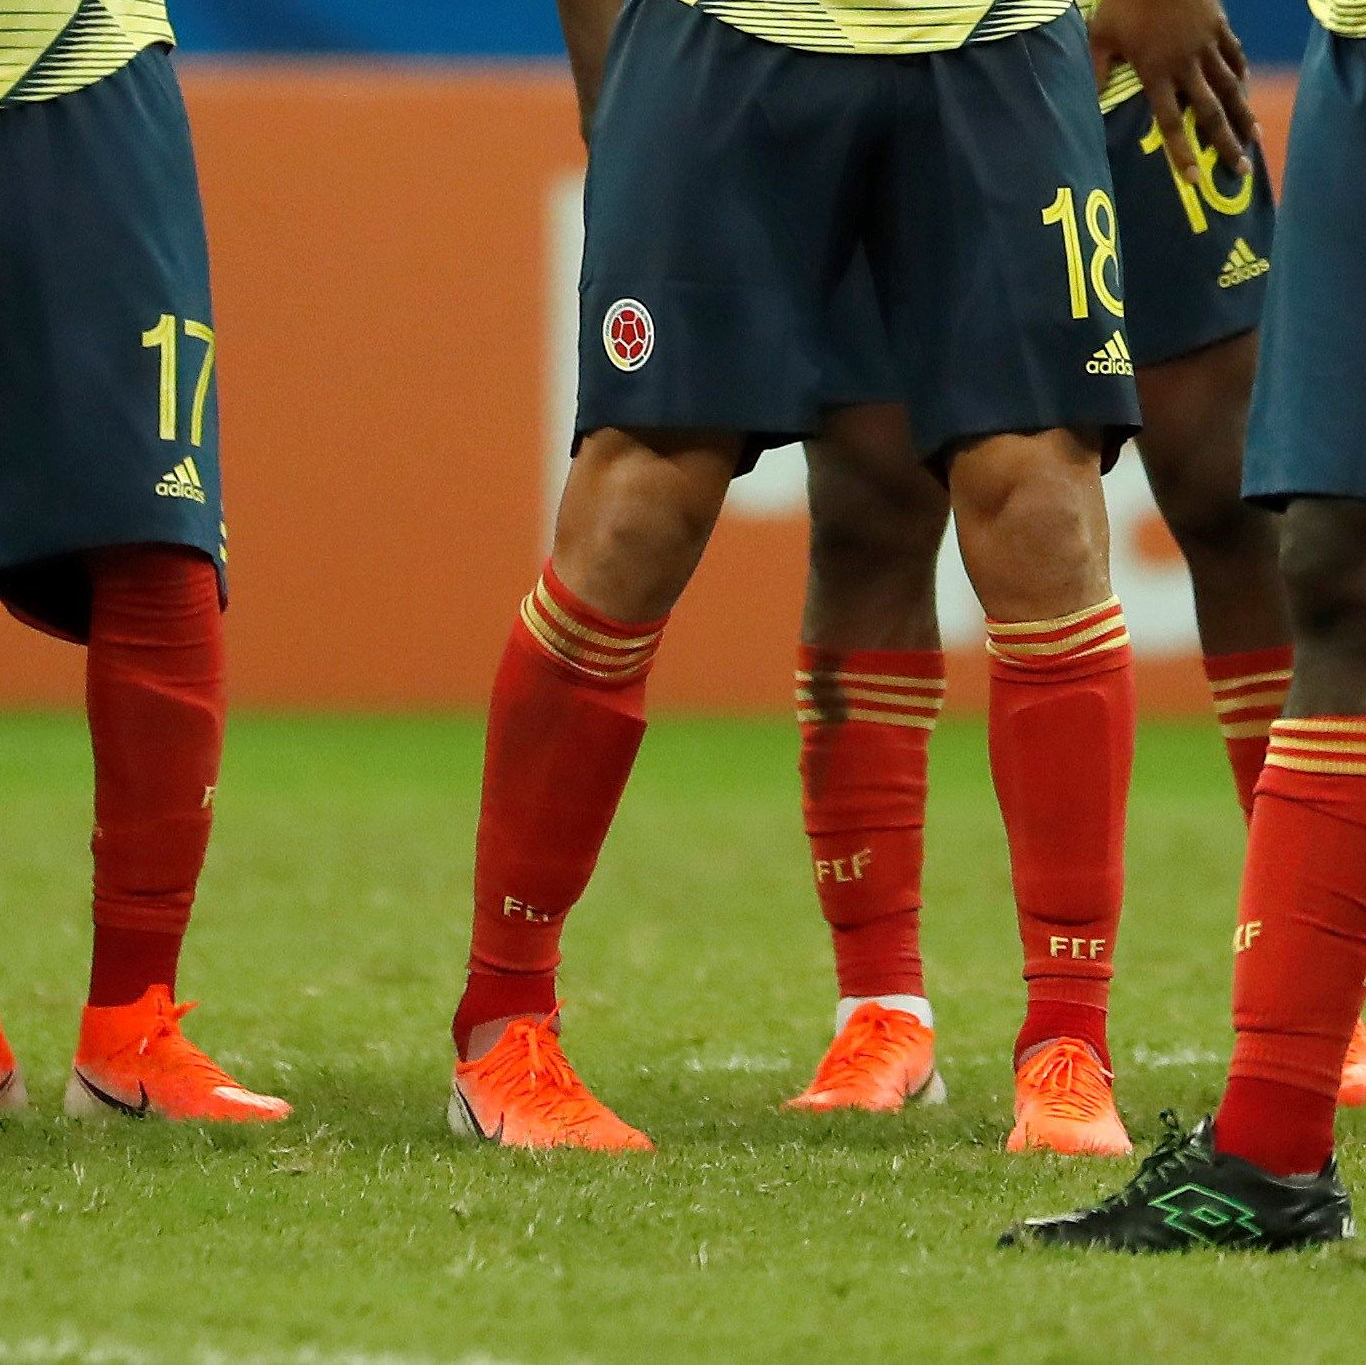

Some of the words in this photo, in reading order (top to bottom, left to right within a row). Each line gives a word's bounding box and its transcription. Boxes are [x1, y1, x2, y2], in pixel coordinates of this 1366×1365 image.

[1041, 187, 1125, 319] 18
[1218, 259, 1271, 288] adidas
[142, 314, 216, 447] 17
[815, 848, 872, 883] FCF
[1050, 936, 1105, 960] FCF
